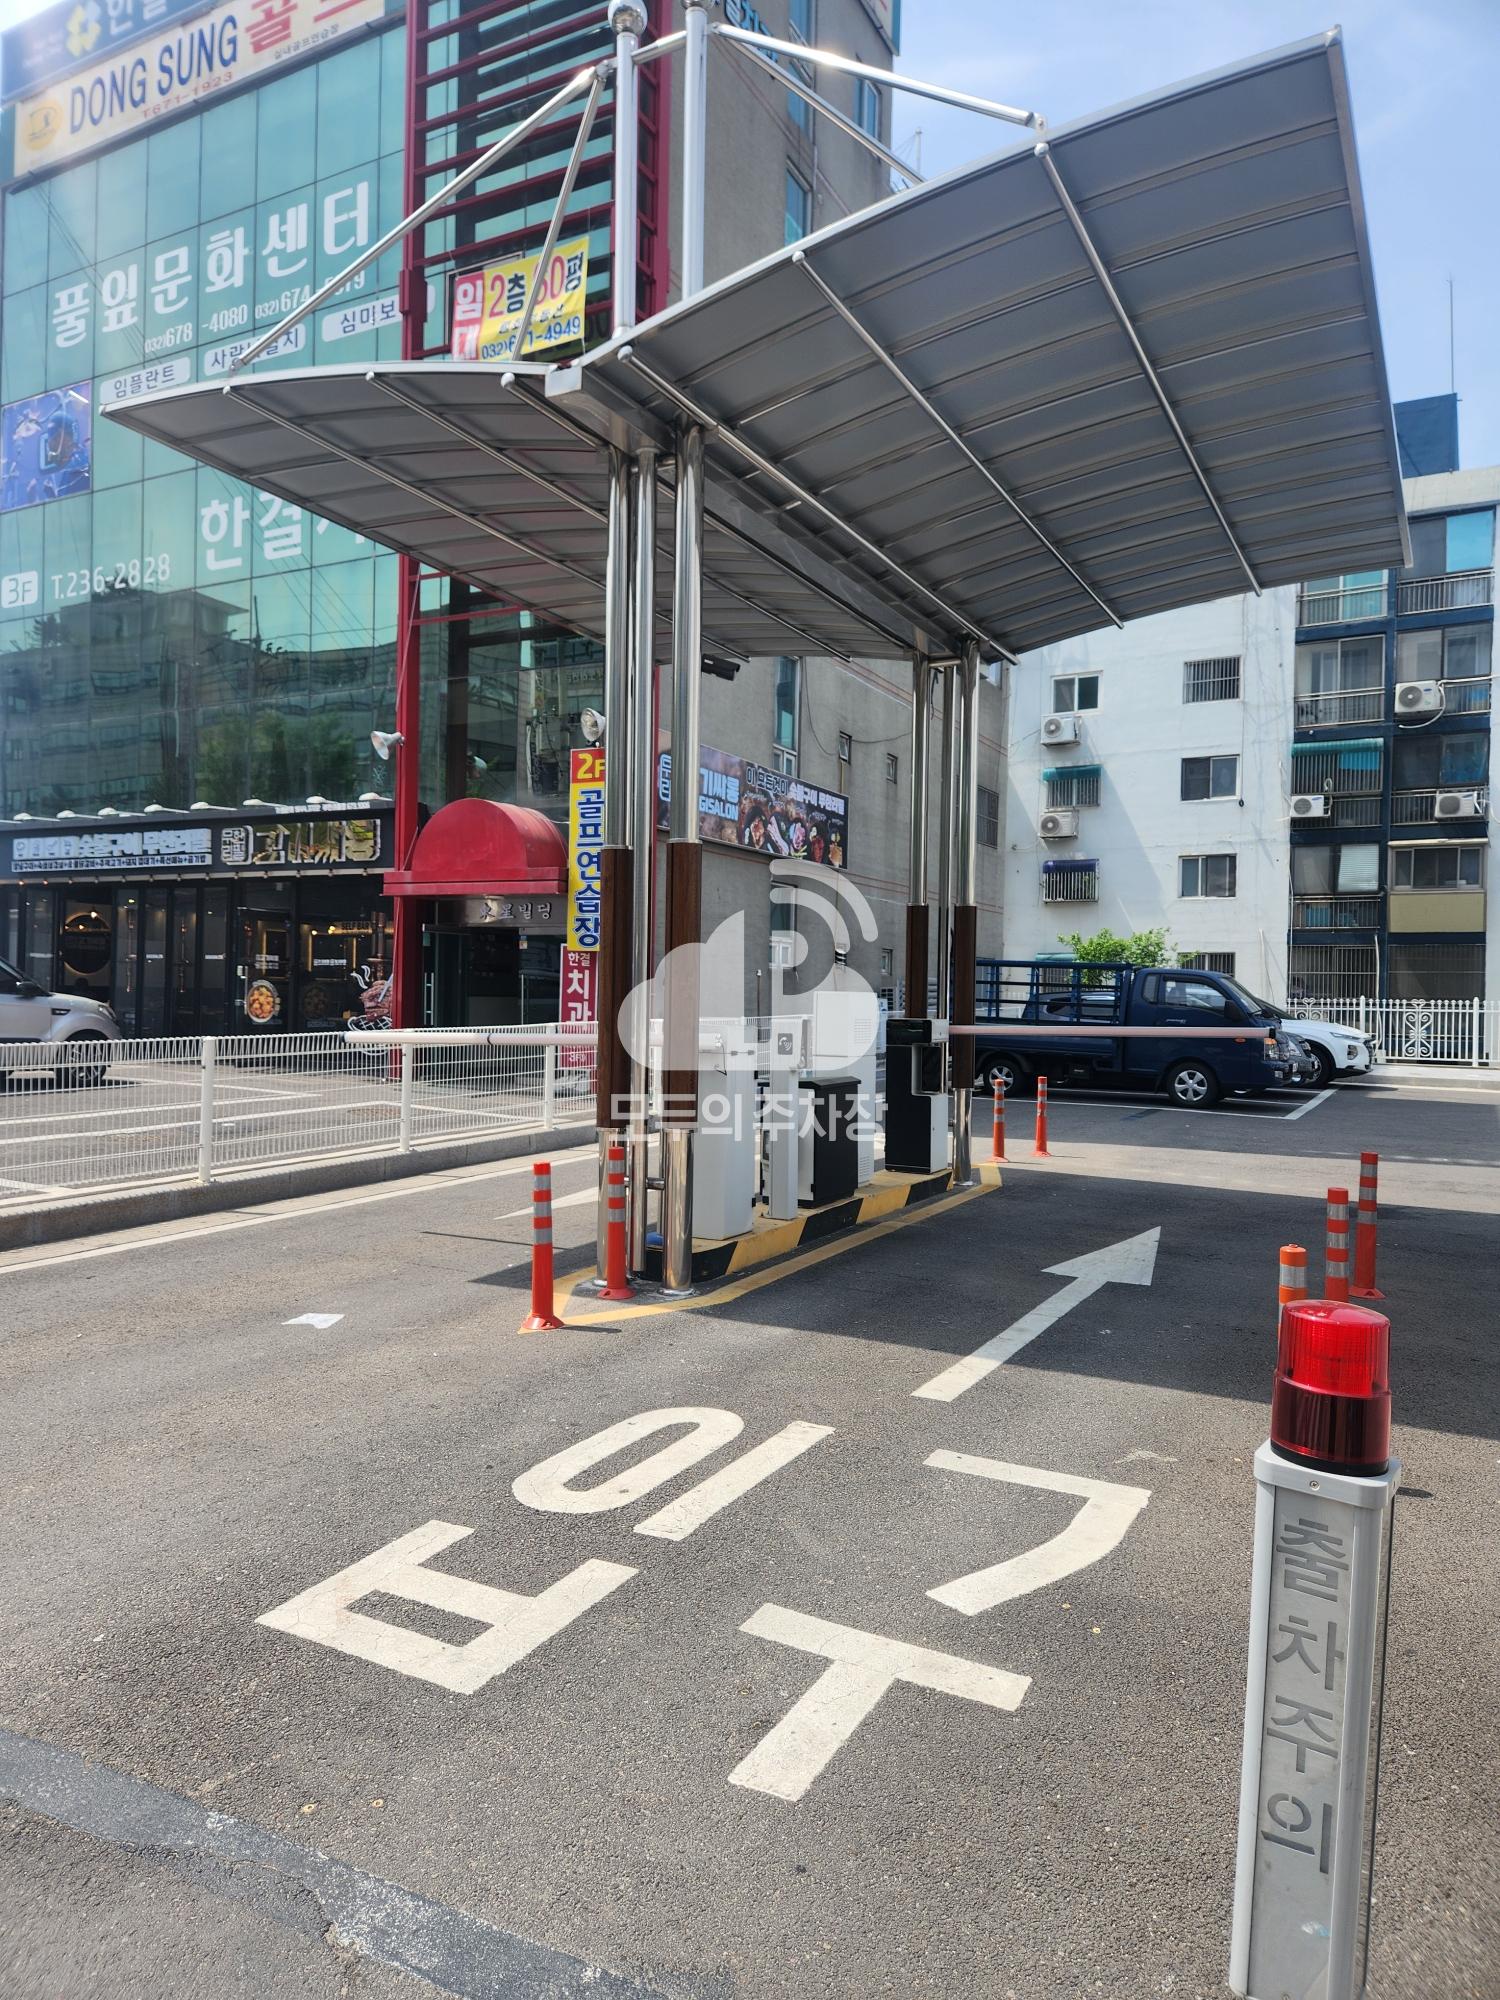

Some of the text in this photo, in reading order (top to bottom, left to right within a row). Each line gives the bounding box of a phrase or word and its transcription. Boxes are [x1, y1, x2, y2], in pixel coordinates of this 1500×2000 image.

[245, 0, 364, 54] 골
[69, 57, 147, 135] DONG
[157, 14, 238, 97] SUNG
[52, 181, 370, 349] 풀잎문화센터
[489, 272, 526, 318] 2층
[481, 315, 582, 359] 032)61-4949
[113, 366, 176, 398] 임플란트
[201, 490, 365, 571] 한결
[8, 553, 171, 604] 3F T.236-2828
[577, 752, 606, 779] 2F
[573, 788, 604, 949] 골프연습장
[568, 952, 591, 967] 한결
[253, 1406, 1153, 1801] 입구
[1260, 1518, 1349, 1874] 출차주의
